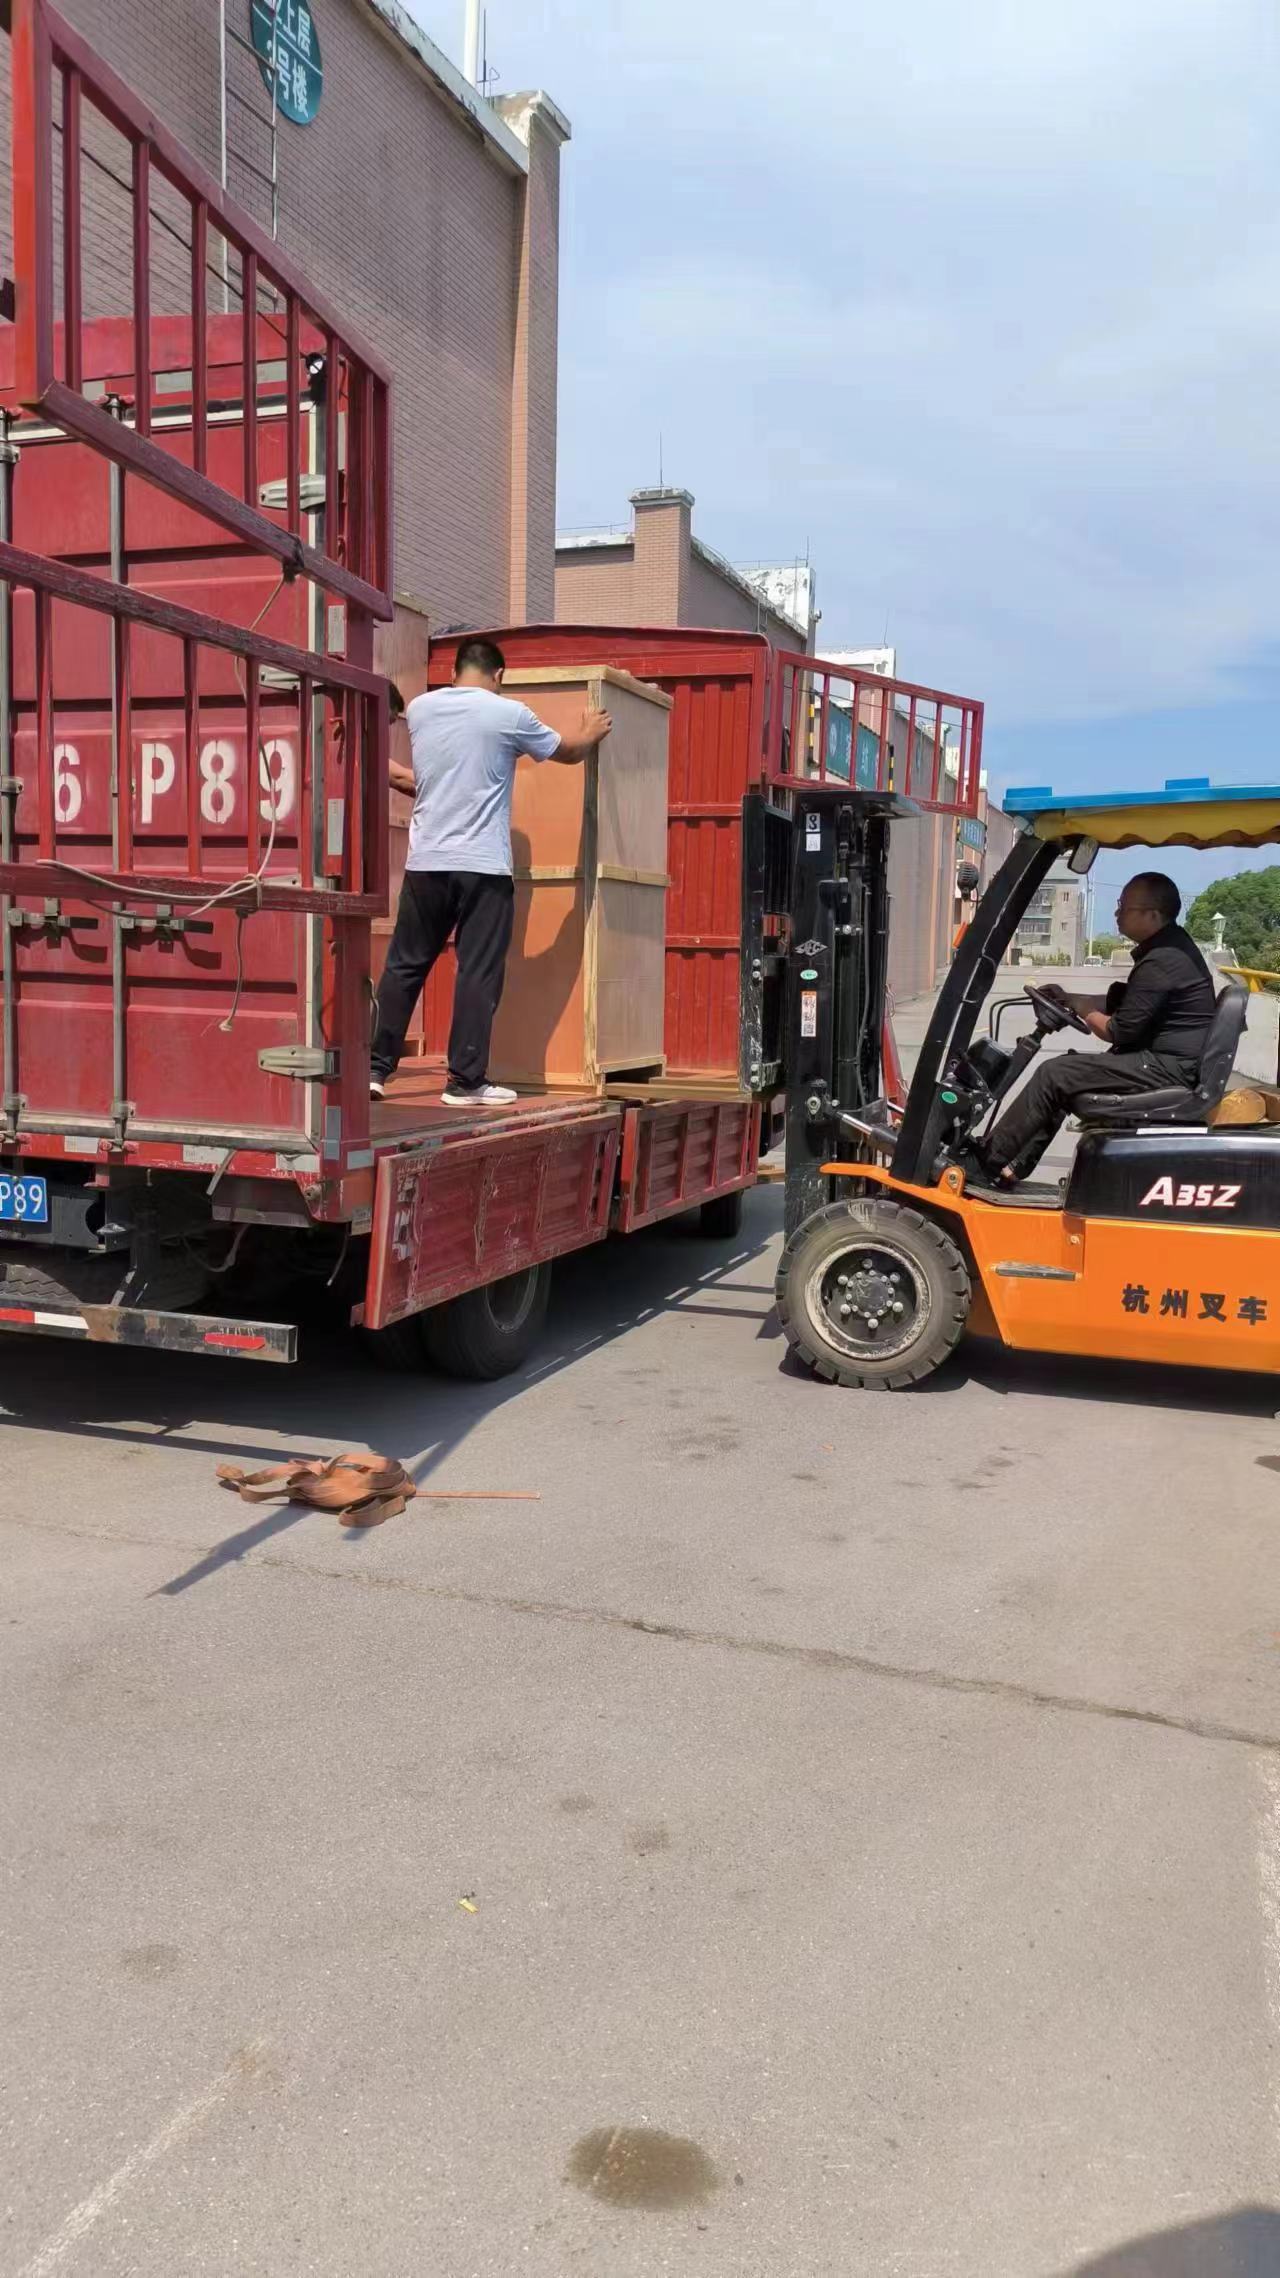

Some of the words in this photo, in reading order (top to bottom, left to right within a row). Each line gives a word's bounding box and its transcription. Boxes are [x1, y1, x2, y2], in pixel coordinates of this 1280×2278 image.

[0, 1181, 43, 1214] P89
[1138, 1175, 1243, 1208] A35Z
[1121, 1283, 1268, 1326] 杭州叉车
